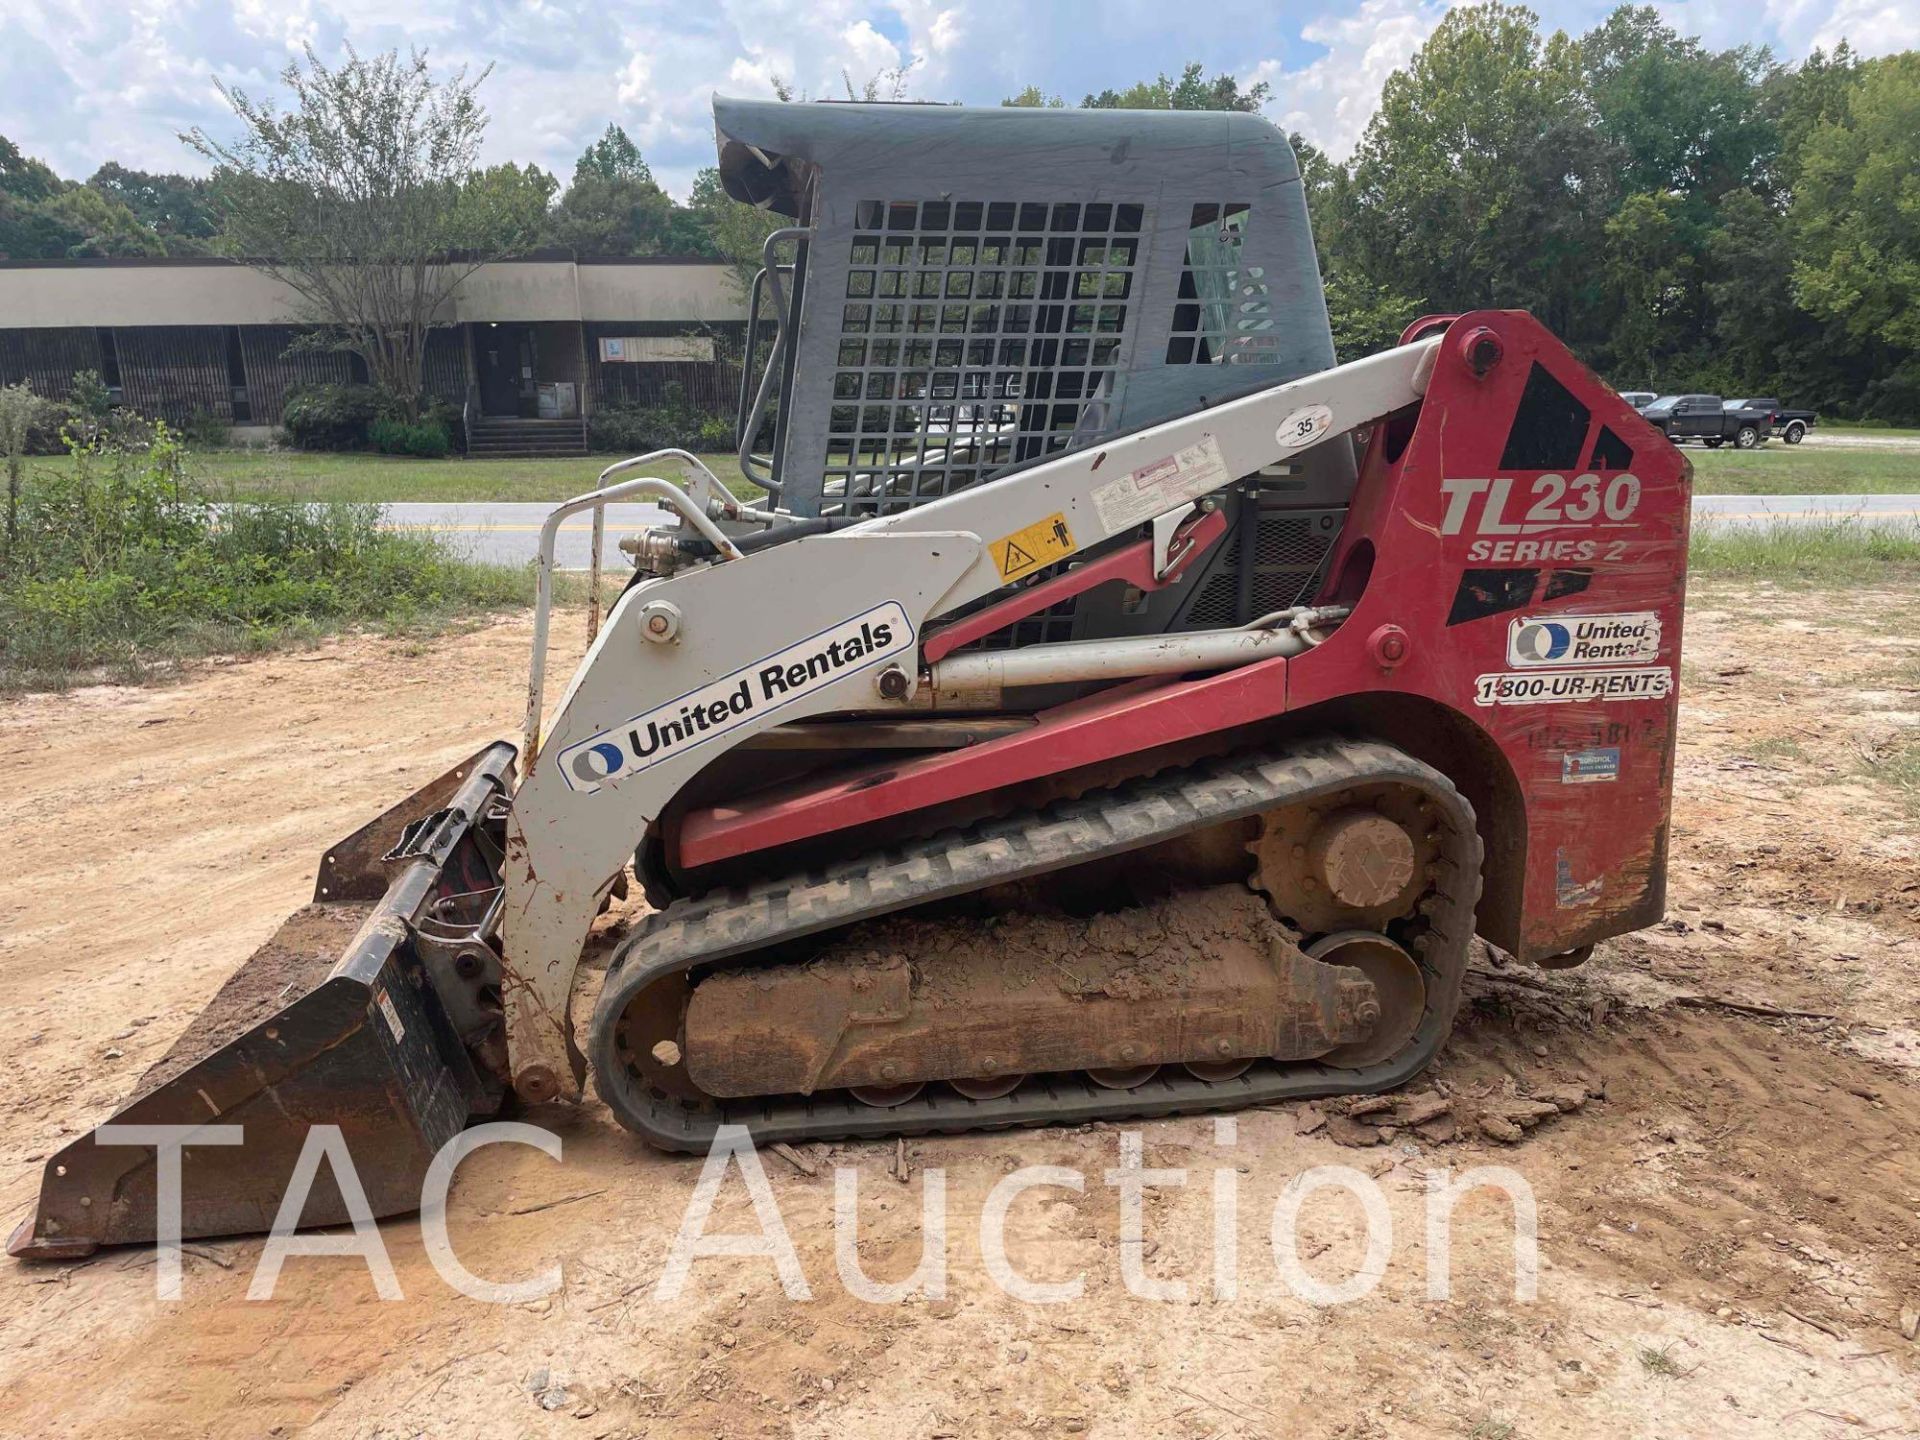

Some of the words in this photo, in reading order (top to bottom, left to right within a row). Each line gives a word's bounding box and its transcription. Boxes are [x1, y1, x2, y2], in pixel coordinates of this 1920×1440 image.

[1297, 417, 1312, 437] 35
[1440, 474, 1641, 535] TL230
[1467, 540, 1597, 562] SERIES
[1603, 540, 1628, 561] 2
[1576, 621, 1645, 640] United
[628, 679, 753, 758] United
[759, 622, 892, 700] Rentals
[1483, 674, 1667, 699] 1-800-UR-RENTS
